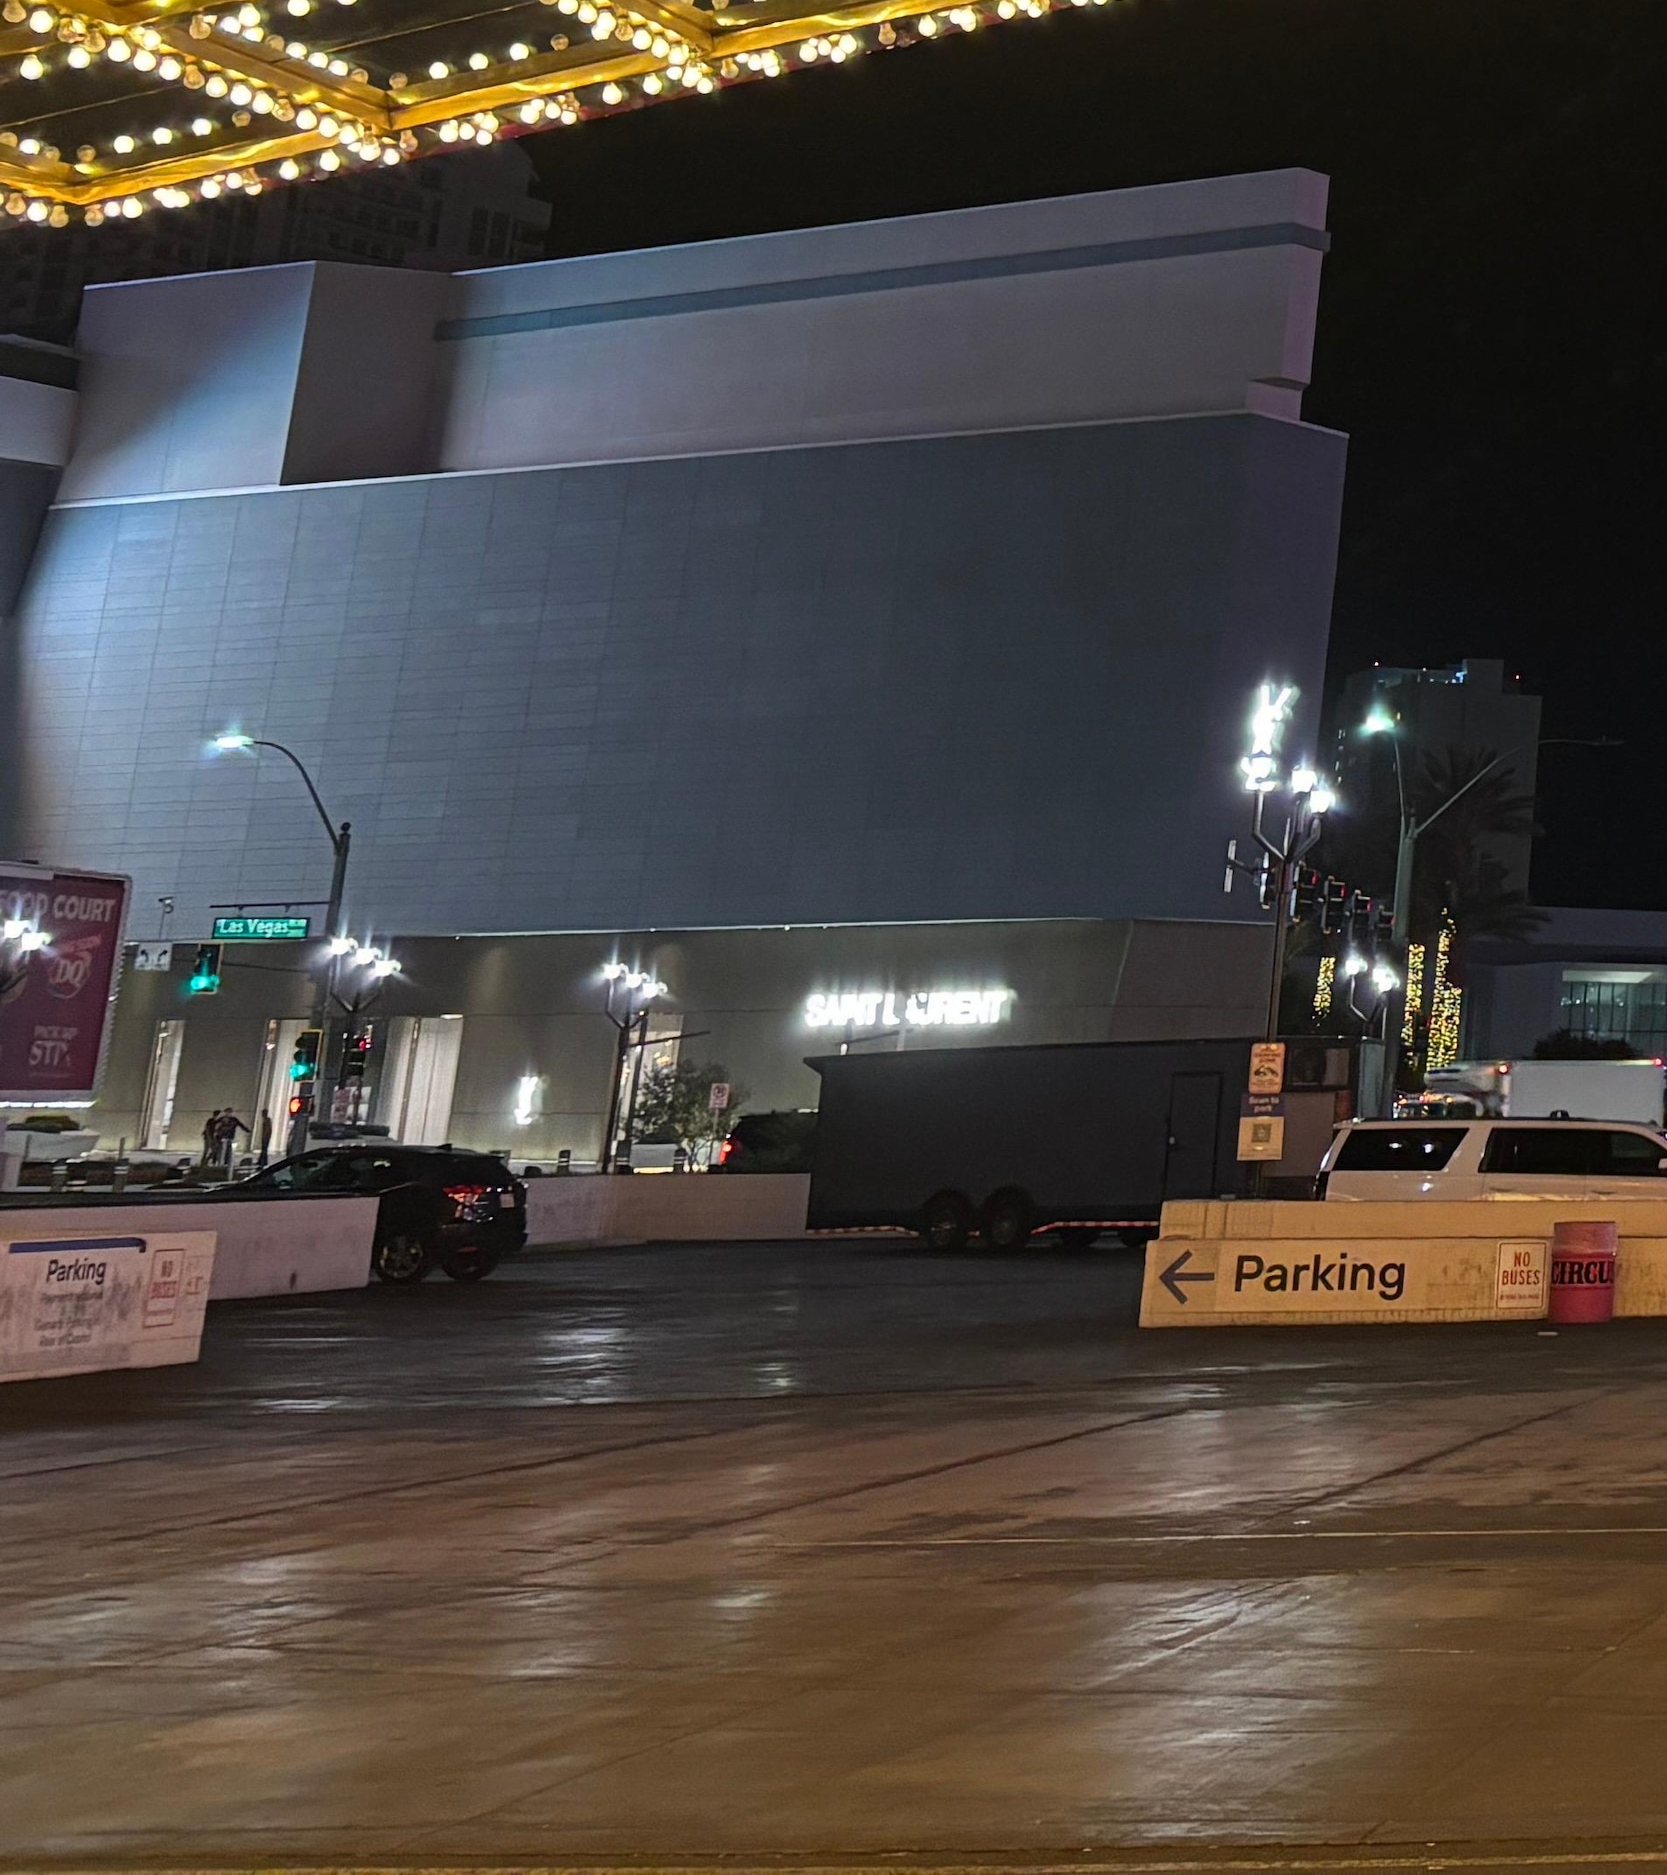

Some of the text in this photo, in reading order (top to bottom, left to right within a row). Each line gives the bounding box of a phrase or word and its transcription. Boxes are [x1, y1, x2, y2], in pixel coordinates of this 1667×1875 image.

[54, 895, 117, 922] COURT
[220, 919, 244, 933] Las
[247, 919, 289, 938] Vegas
[1513, 1251, 1531, 1267] NO
[46, 1257, 107, 1285] Parking
[1234, 1252, 1406, 1301] Parking
[1502, 1270, 1541, 1285] BUSES
